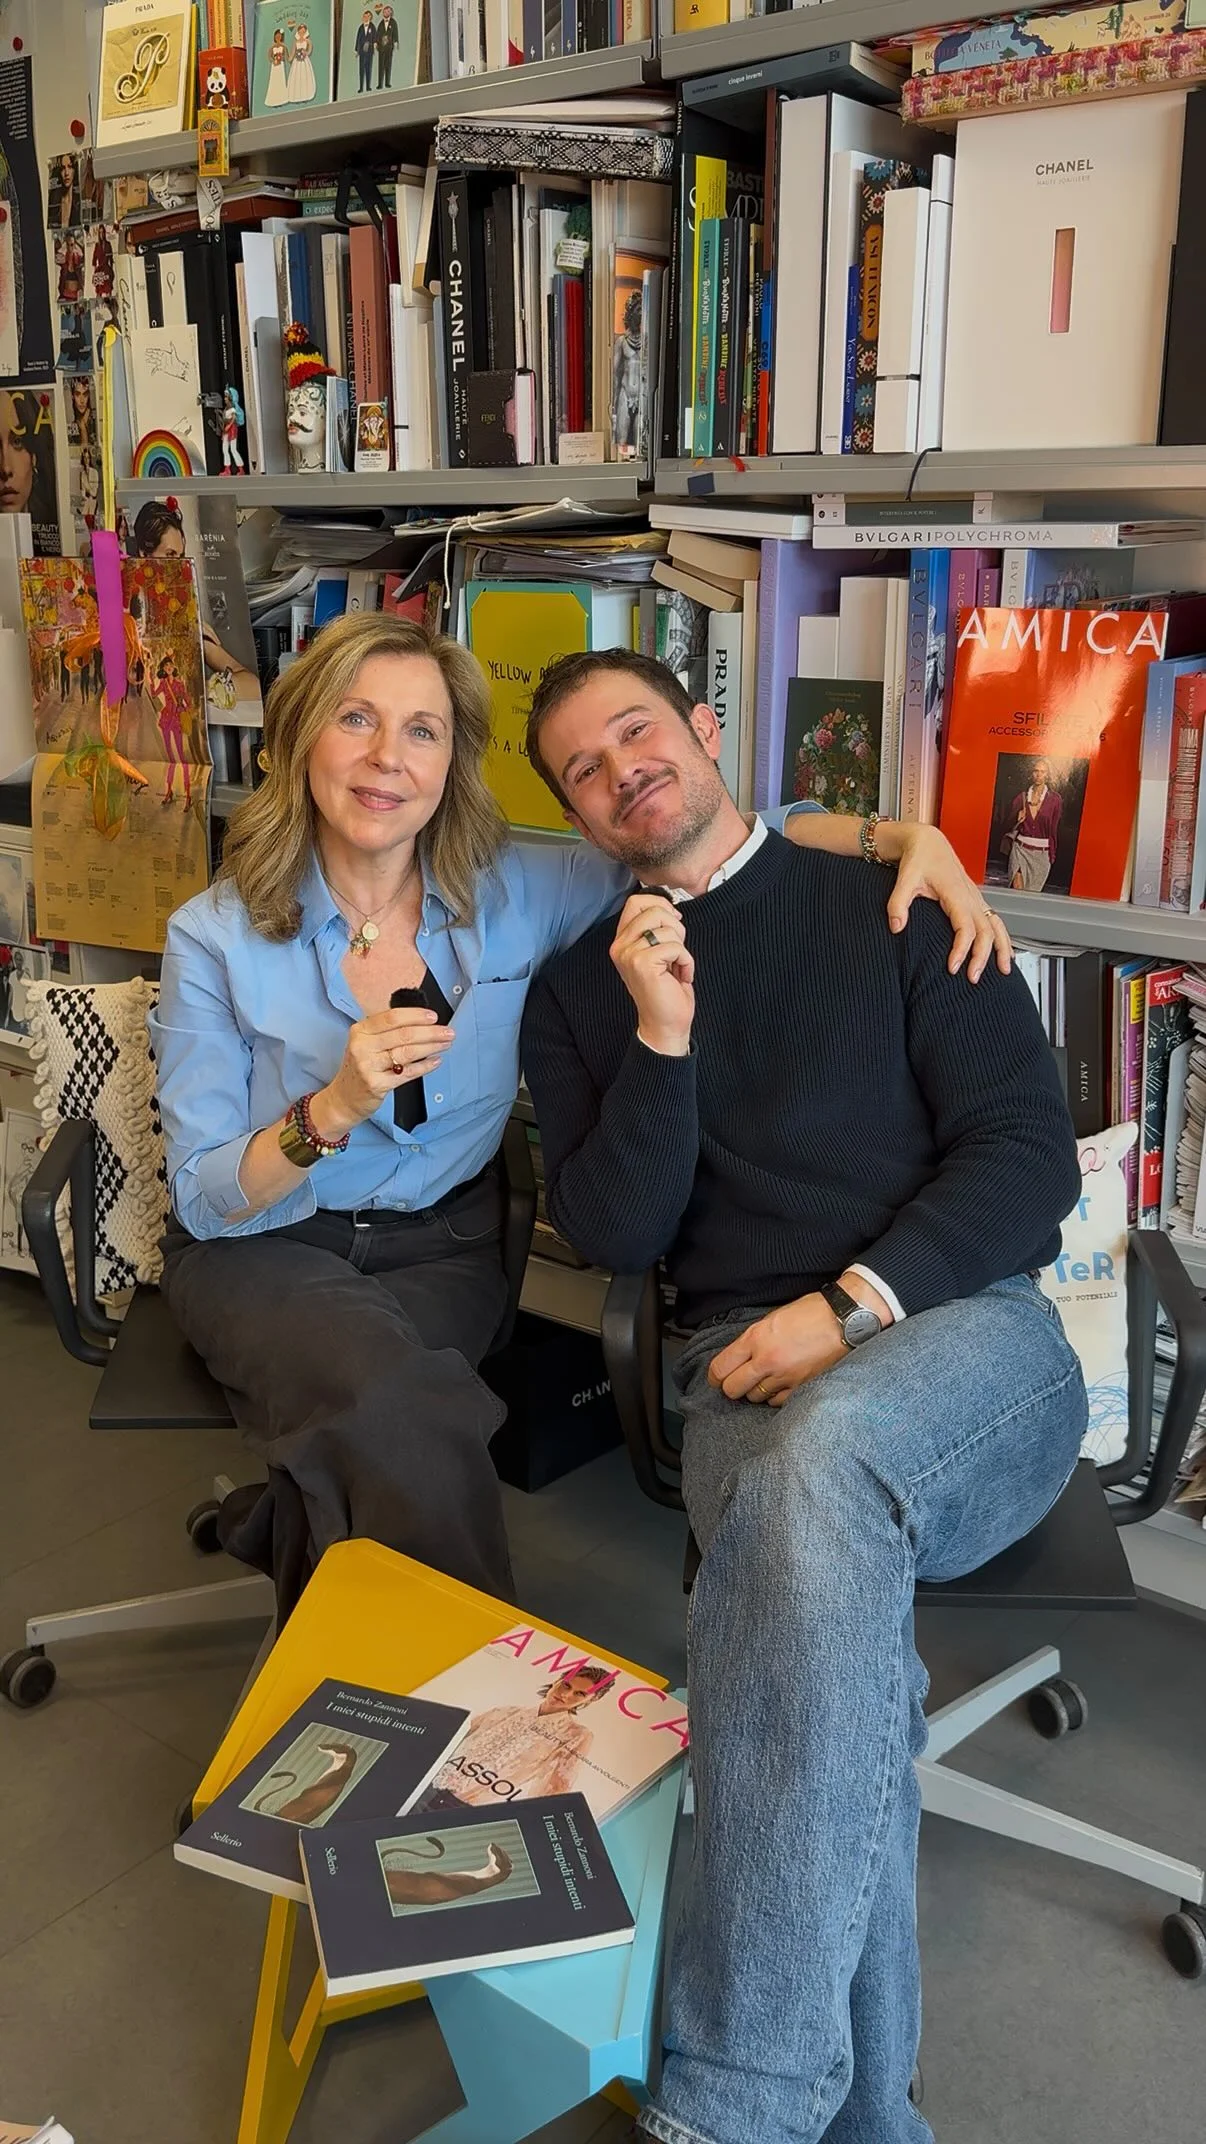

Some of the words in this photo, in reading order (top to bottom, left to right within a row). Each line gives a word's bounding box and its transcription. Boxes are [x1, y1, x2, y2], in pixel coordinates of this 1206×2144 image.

[1035, 159, 1094, 176] CHANEL
[449, 259, 466, 373] CHANEL
[453, 378, 461, 441] JOAILLERIE
[854, 531, 932, 544] BVLGARI
[934, 529, 1053, 543] POLYCHROMA
[909, 568, 929, 709] BVLGARI
[957, 611, 1169, 656] AMICA
[488, 659, 532, 684] YELLOW
[1080, 1060, 1089, 1103] AMICA
[1054, 1251, 1116, 1284] TeR
[336, 1690, 374, 1706] Bernardo
[374, 1700, 409, 1716] Zannoni
[489, 1629, 689, 1749] AMICA
[332, 1704, 357, 1716] miei
[355, 1710, 393, 1727] stupidi
[391, 1718, 428, 1735] intenti
[210, 1831, 243, 1848] Sellerio
[544, 1820, 562, 1843] miei
[563, 1811, 584, 1848] Bernardo
[577, 1841, 598, 1881] Zannoni
[324, 1846, 338, 1876] Sellerio
[552, 1842, 576, 1878] stupidi
[564, 1877, 588, 1912] intenti
